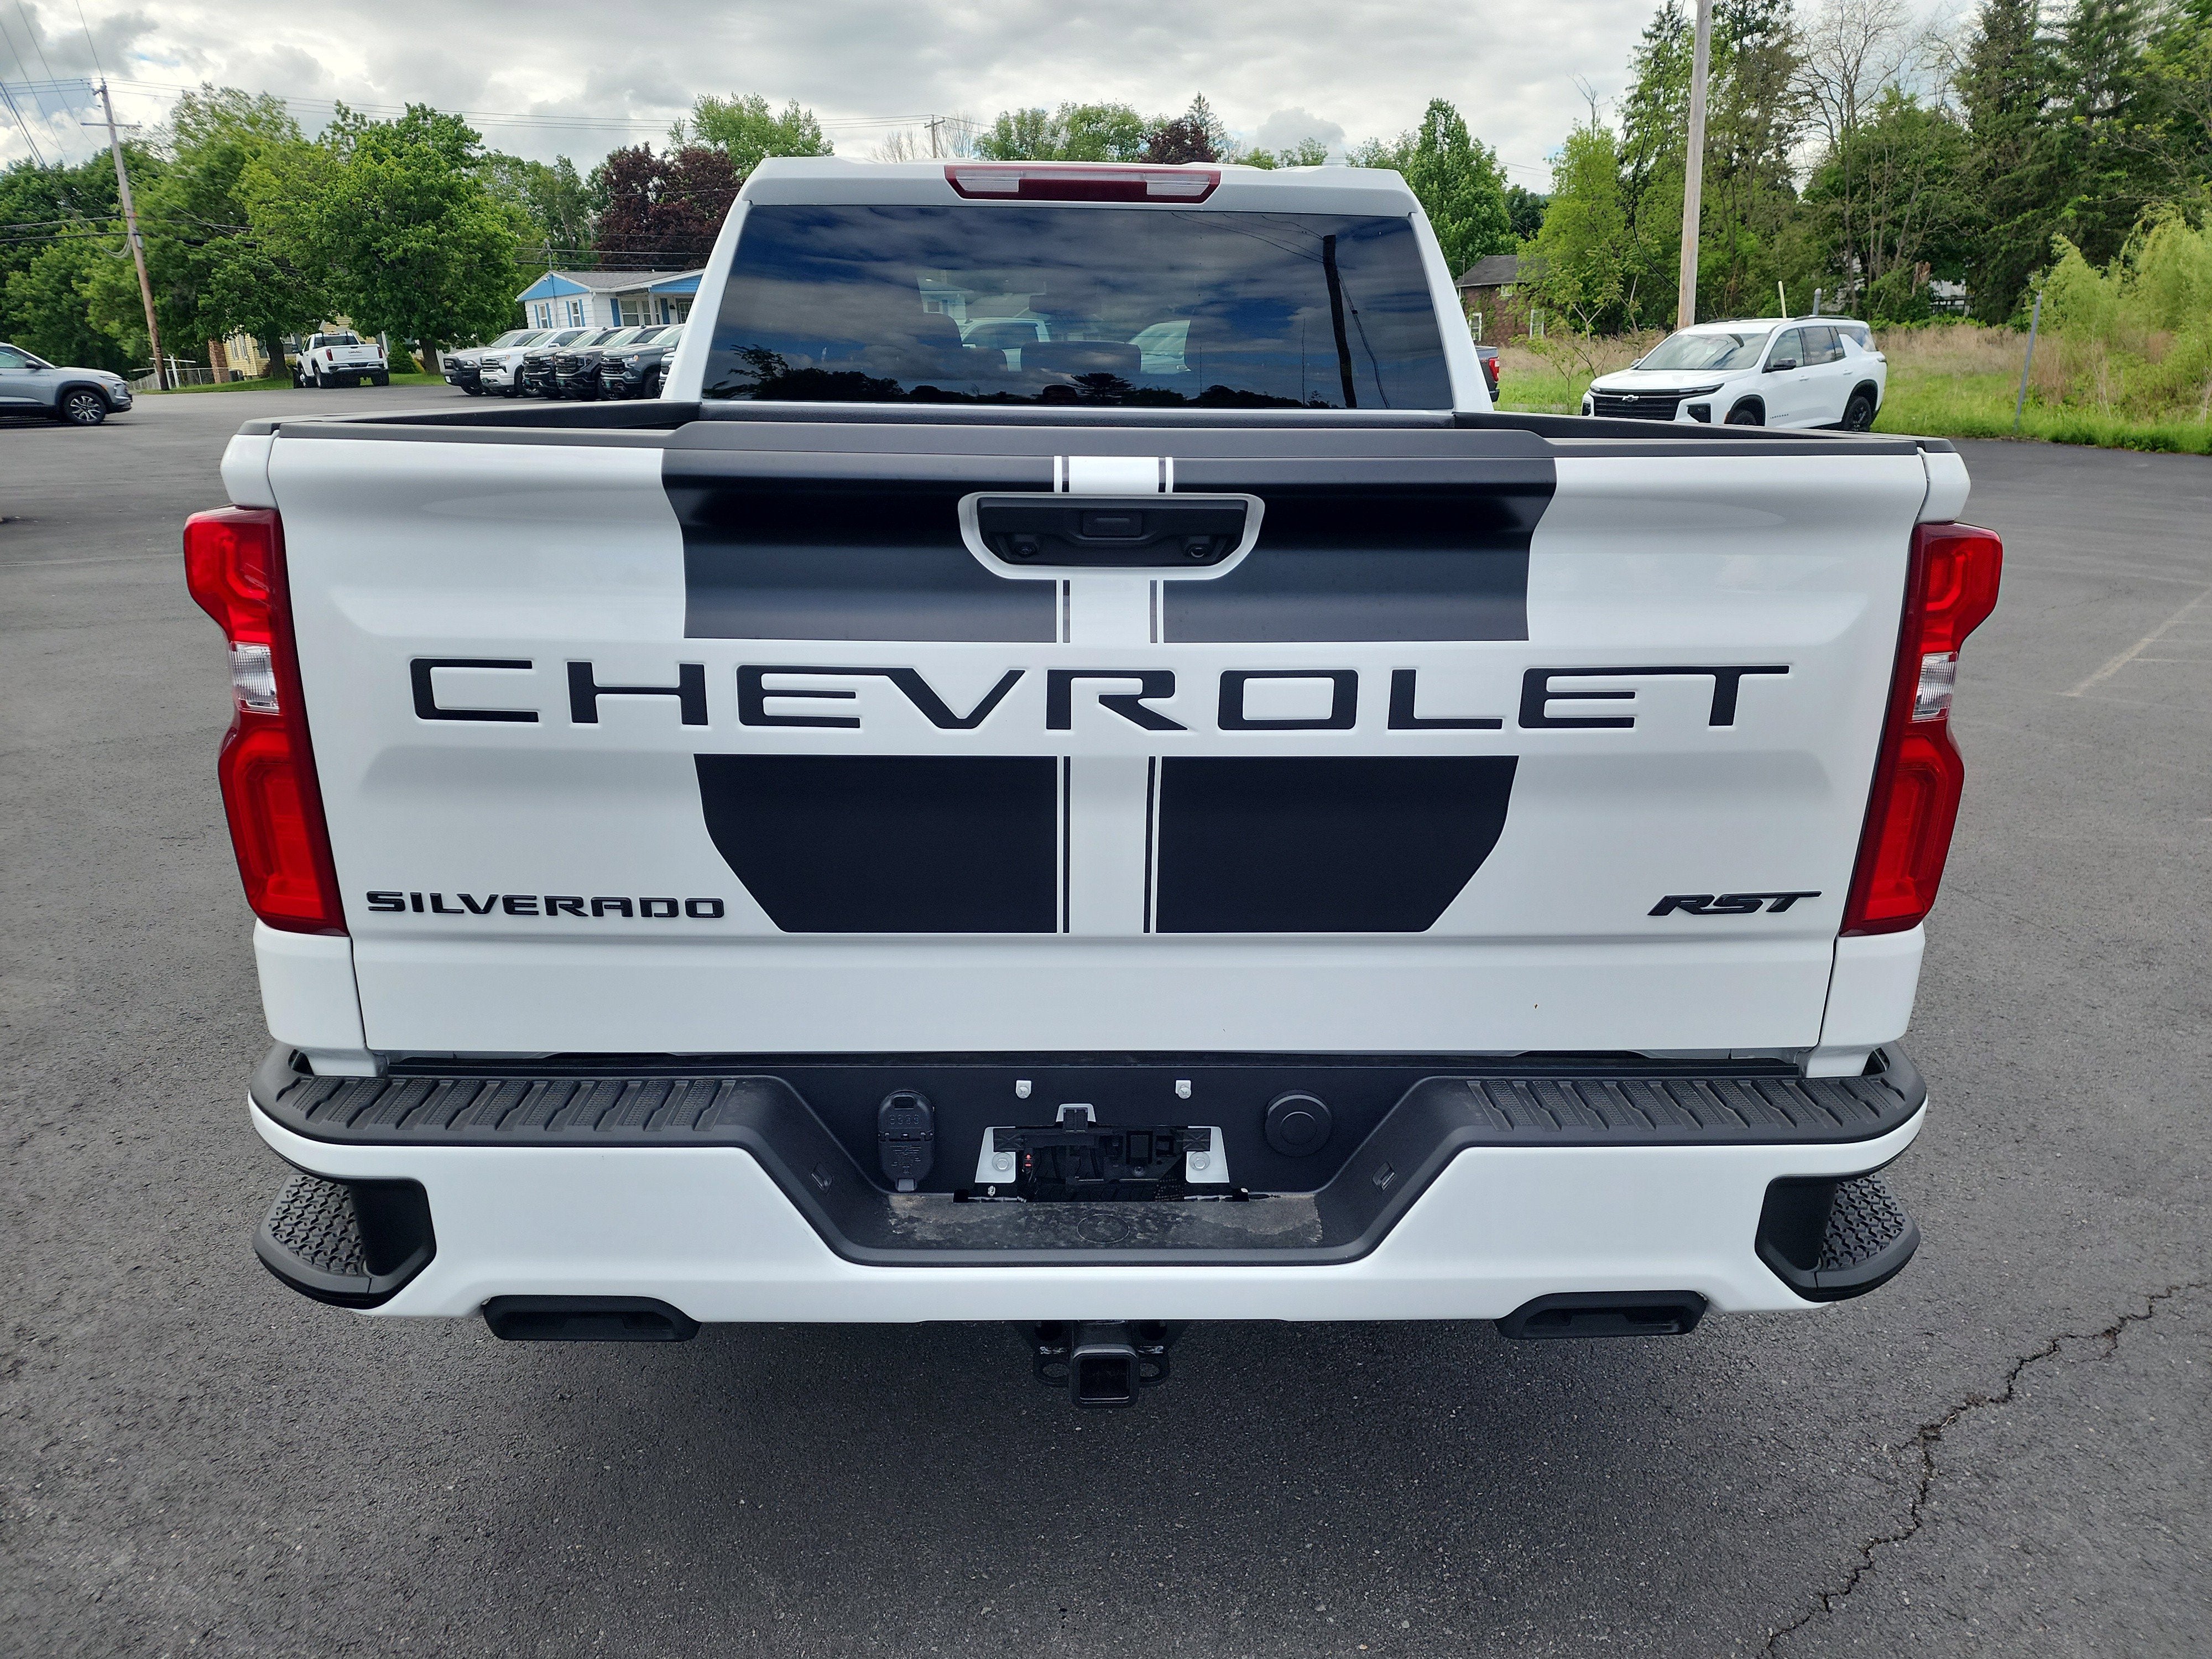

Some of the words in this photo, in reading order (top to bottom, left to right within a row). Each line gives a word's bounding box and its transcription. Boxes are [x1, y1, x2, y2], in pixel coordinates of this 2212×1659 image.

[410, 658, 1790, 731] CHEVROLET
[366, 891, 725, 919] SILVERADO
[1647, 891, 1822, 917] RST
